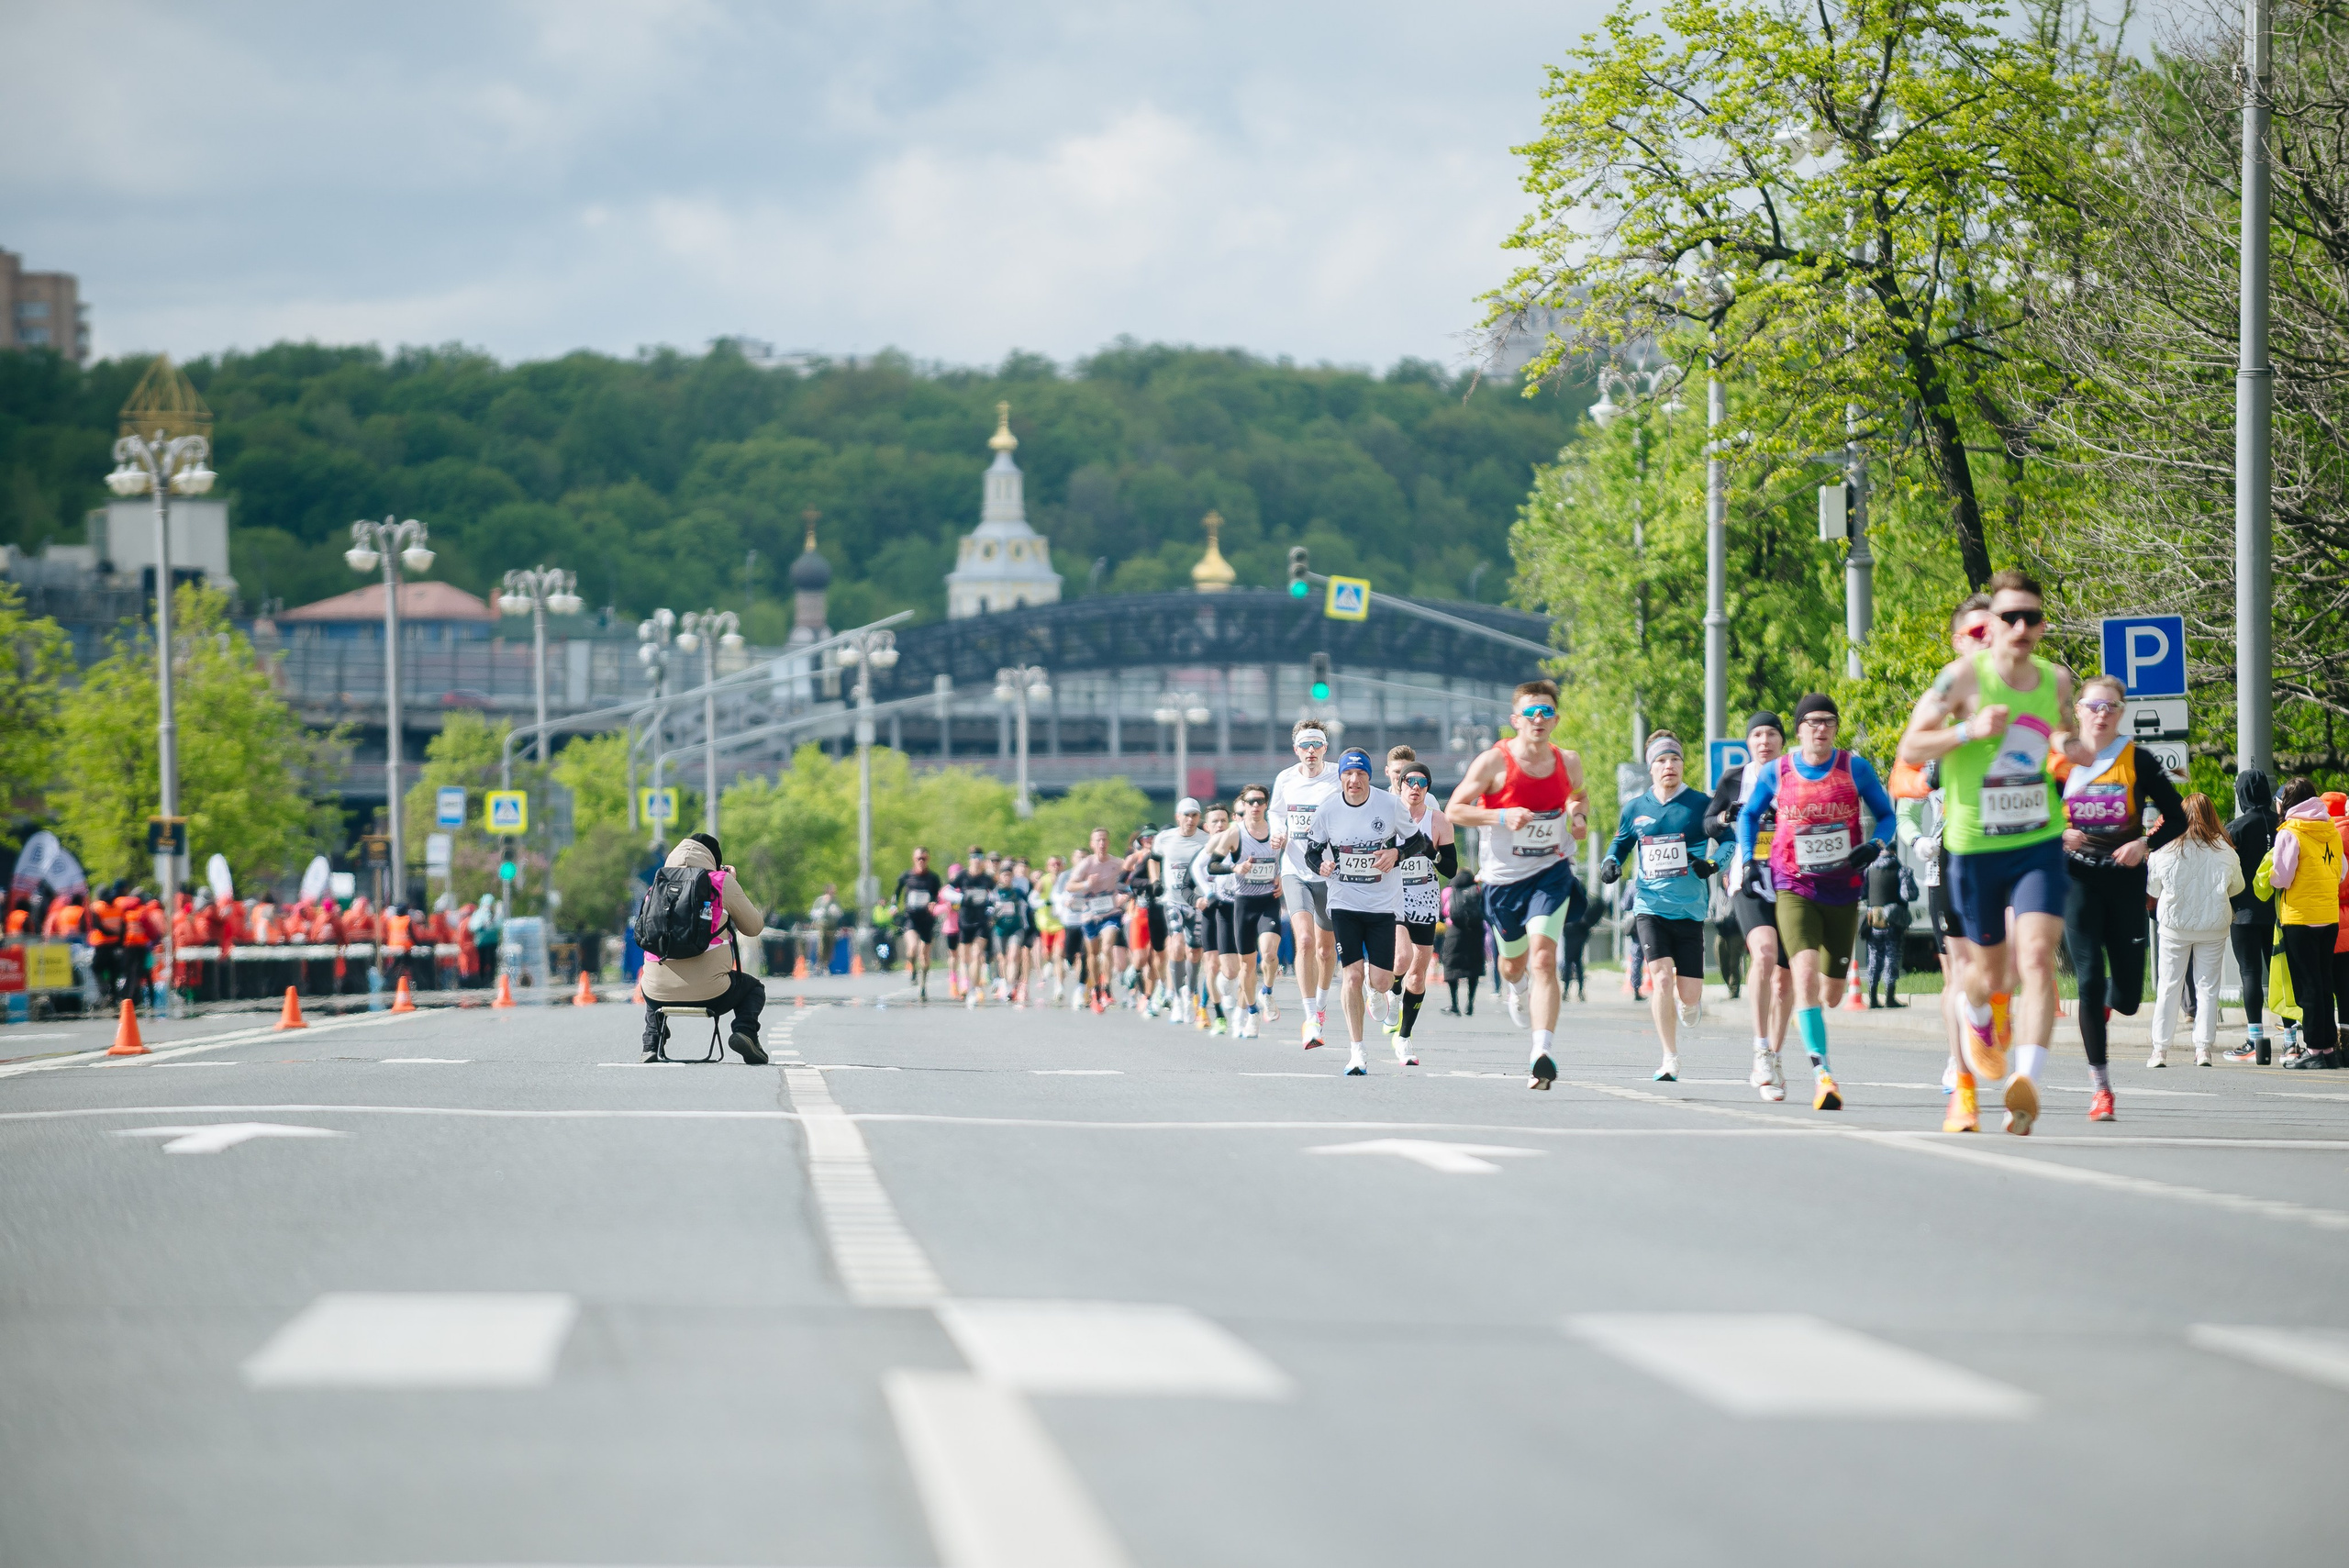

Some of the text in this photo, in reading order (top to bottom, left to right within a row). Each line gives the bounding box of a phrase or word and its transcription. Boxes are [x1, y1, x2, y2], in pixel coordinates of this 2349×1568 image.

[2125, 625, 2169, 688] P
[1721, 745, 1751, 776] P
[1987, 790, 2043, 811] 10060
[2072, 801, 2126, 819] 205-3
[1290, 815, 1311, 826] 1336
[1527, 824, 1553, 838] 764
[1805, 837, 1843, 854] 3283
[1345, 857, 1375, 869] 4787
[1649, 847, 1679, 862] 6940
